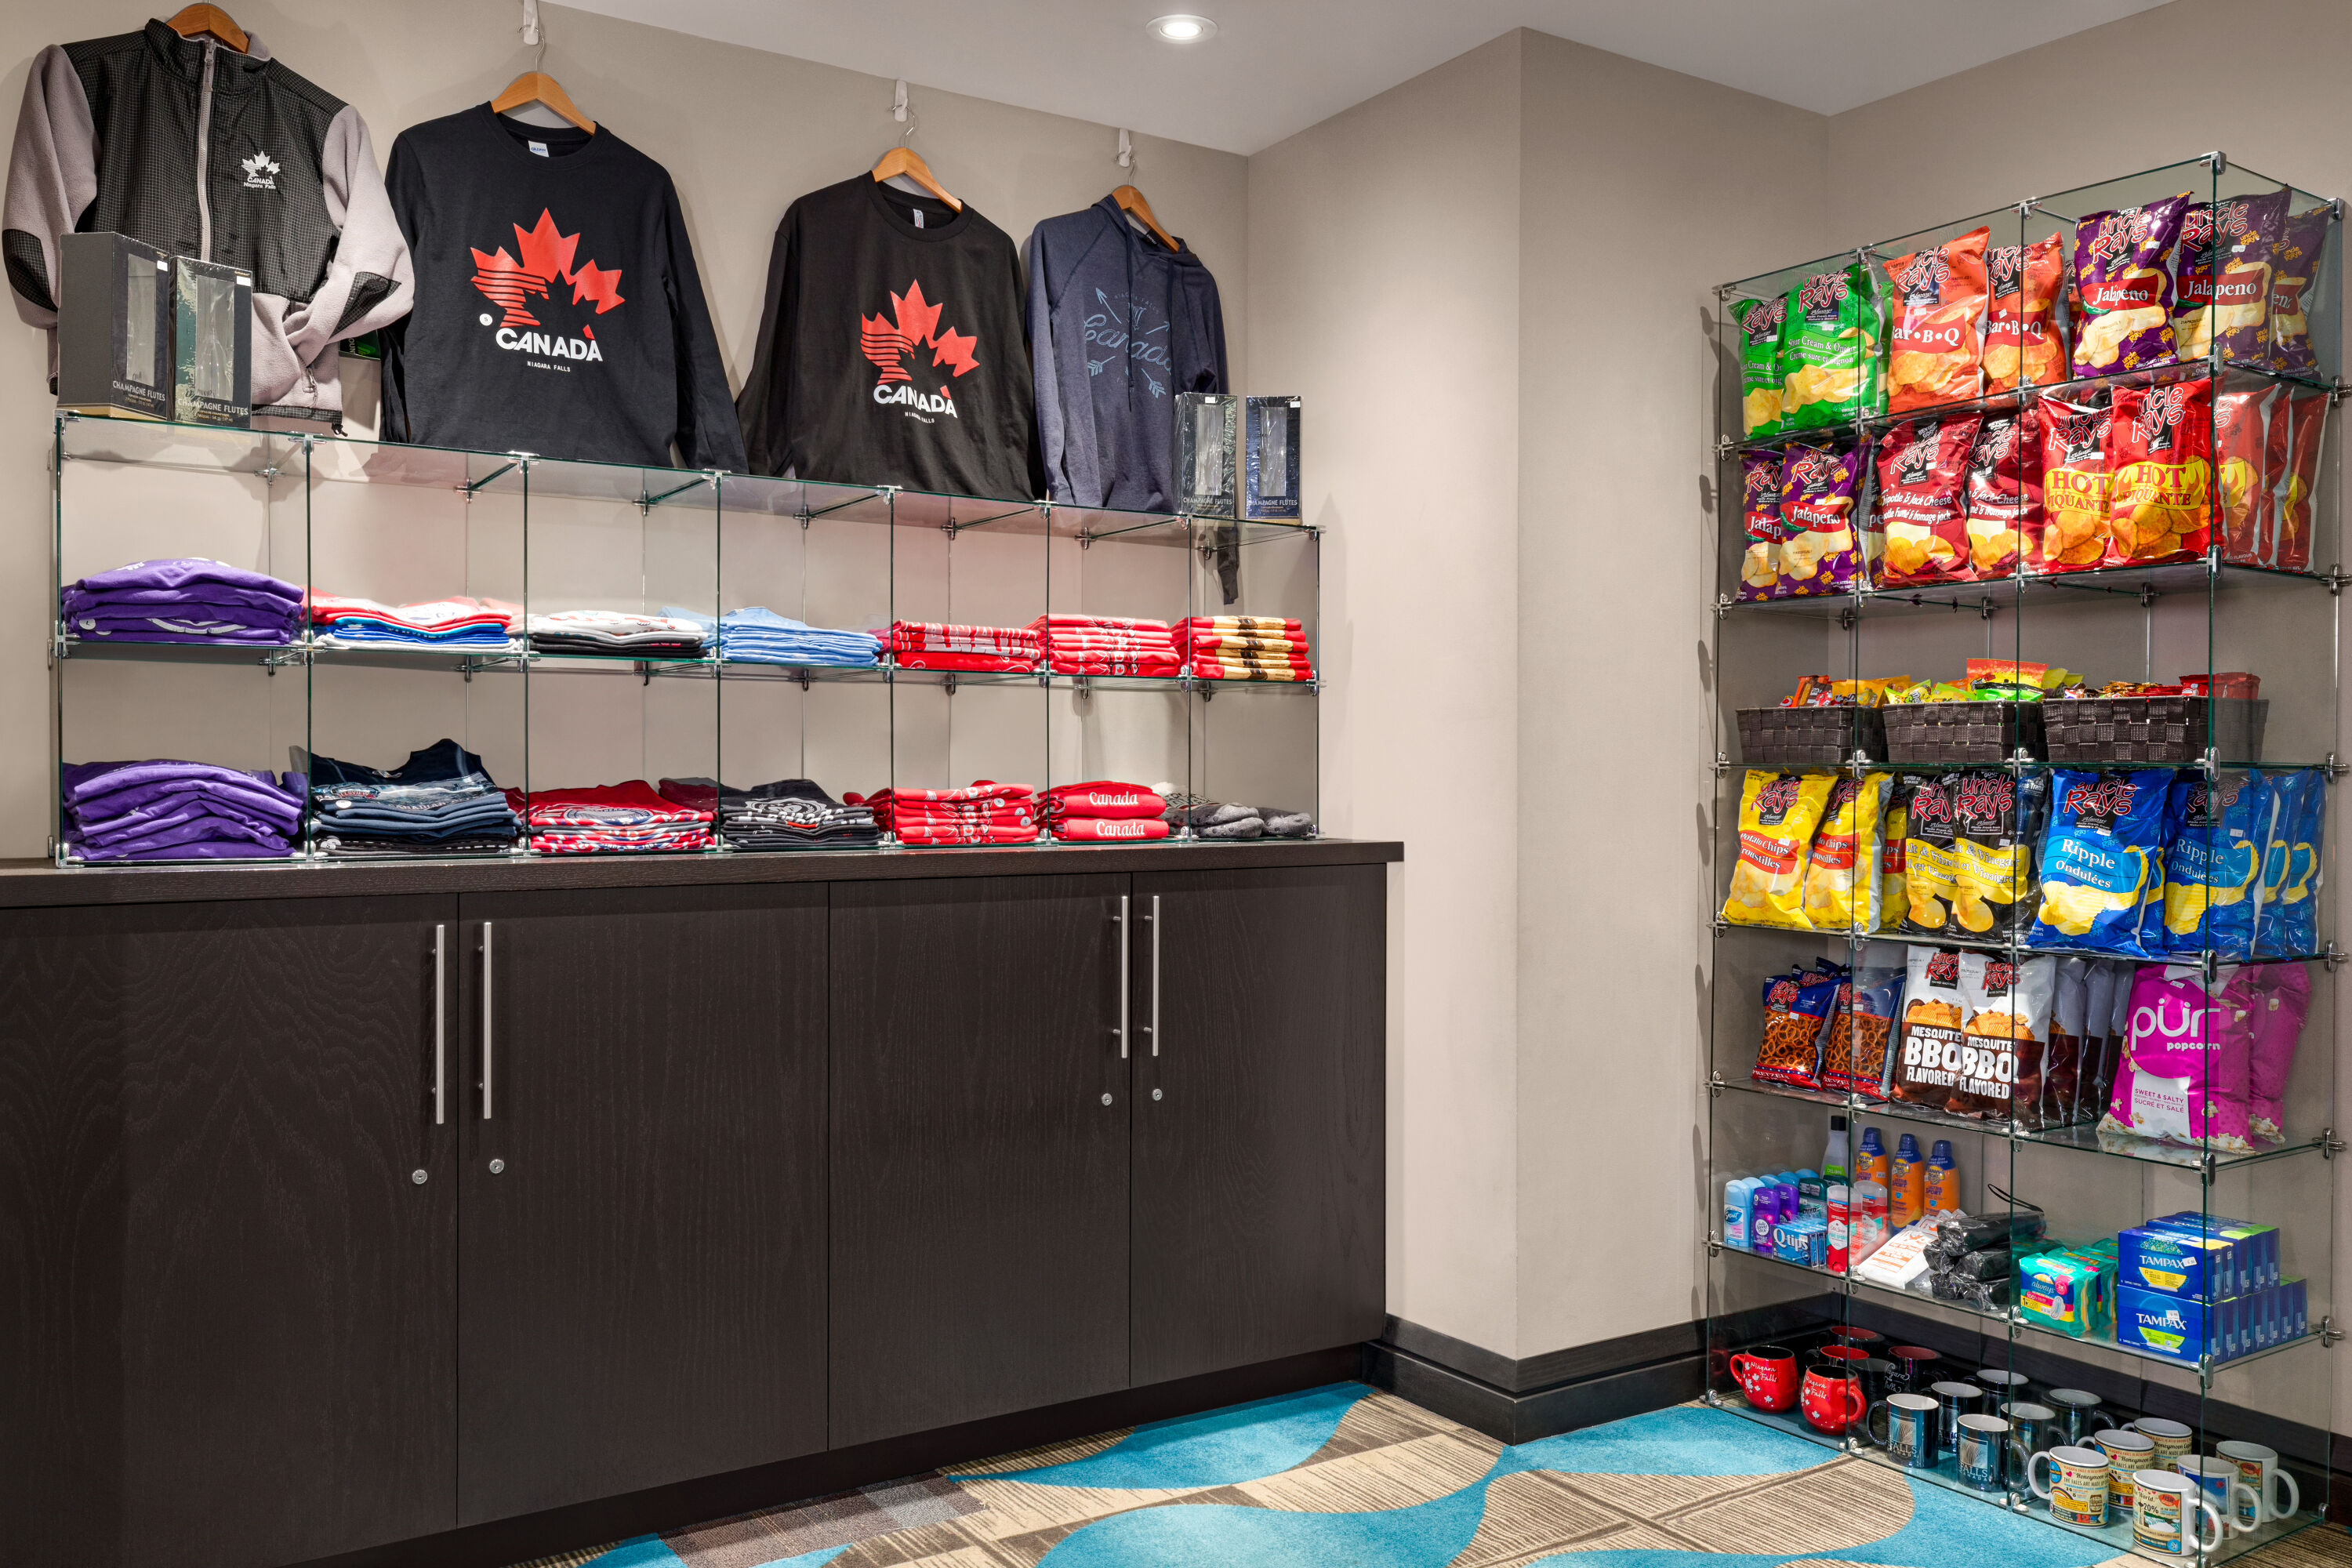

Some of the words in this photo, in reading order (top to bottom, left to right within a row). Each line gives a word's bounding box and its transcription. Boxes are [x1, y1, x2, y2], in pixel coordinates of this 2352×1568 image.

[2099, 207, 2152, 238] uncle
[2184, 201, 2249, 228] uncle
[1803, 270, 1852, 289] uncle
[2092, 287, 2148, 307] Jalapeno
[2184, 279, 2256, 299] Jalapeno
[495, 328, 603, 361] CANADA
[1788, 339, 1800, 348] Sour
[1802, 336, 1824, 350] Cream
[1790, 352, 1806, 361] Crème
[527, 361, 551, 370] NIAGARA
[1748, 361, 1765, 370] Cream
[112, 380, 146, 396] CHAMPAGNE
[147, 390, 165, 401] FLUTES
[177, 398, 222, 411] CHAMPAGNE
[223, 405, 249, 416] FLUTES
[873, 384, 957, 418] CANADA
[2053, 470, 2111, 495] HOT
[2136, 465, 2187, 489] HOT
[1910, 494, 1923, 505] Jack
[1924, 495, 1952, 506] Cheese
[1997, 494, 2029, 503] Cheese
[2124, 489, 2191, 506] PIQUANTE
[1791, 506, 1840, 528] Jalapeno
[1936, 510, 1951, 524] jack
[1748, 516, 1781, 540] Jalap
[1963, 774, 2016, 796] uncle
[1089, 791, 1138, 806] Canada
[1096, 817, 1145, 837] Canada
[1740, 833, 1762, 847] Potato
[1762, 841, 1789, 855] Chips
[1826, 837, 1848, 848] Chips
[2176, 838, 2224, 864] Ripple
[1813, 851, 1841, 864] oustilles
[1921, 848, 1929, 857] &
[1965, 846, 1976, 856] &
[1977, 849, 2020, 868] Vinegar
[2061, 839, 2115, 869] Ripple
[1928, 867, 1956, 882] Vinaig
[1962, 862, 1970, 871] et
[1973, 865, 2014, 884] Vinaigre
[2056, 860, 2111, 887] Ondulées
[2172, 862, 2219, 883] Ondulées
[2131, 998, 2221, 1051] pür
[1911, 1026, 1962, 1041] MESQUITE
[1967, 1036, 2014, 1051] MESQUITE
[2166, 1042, 2220, 1051] popcorn
[1962, 1047, 2020, 1084] BBQ
[1906, 1065, 1955, 1087] FLAVORED
[1959, 1076, 2010, 1099] FLAVORED
[2135, 1088, 2155, 1097] SWEET
[2135, 1098, 2154, 1107] SUCRÉ
[1773, 1229, 1808, 1251] Q-tips
[2140, 1255, 2184, 1269] TAMPAX
[2032, 1281, 2054, 1294] always
[2136, 1313, 2187, 1330] TAMPAX
[1750, 1361, 1777, 1372] Niagara
[1761, 1374, 1777, 1383] Falls
[1805, 1375, 1827, 1389] Niagara
[1811, 1388, 1828, 1399] Falls
[2143, 1503, 2158, 1513] 20%
[2077, 1514, 2090, 1523] 12
